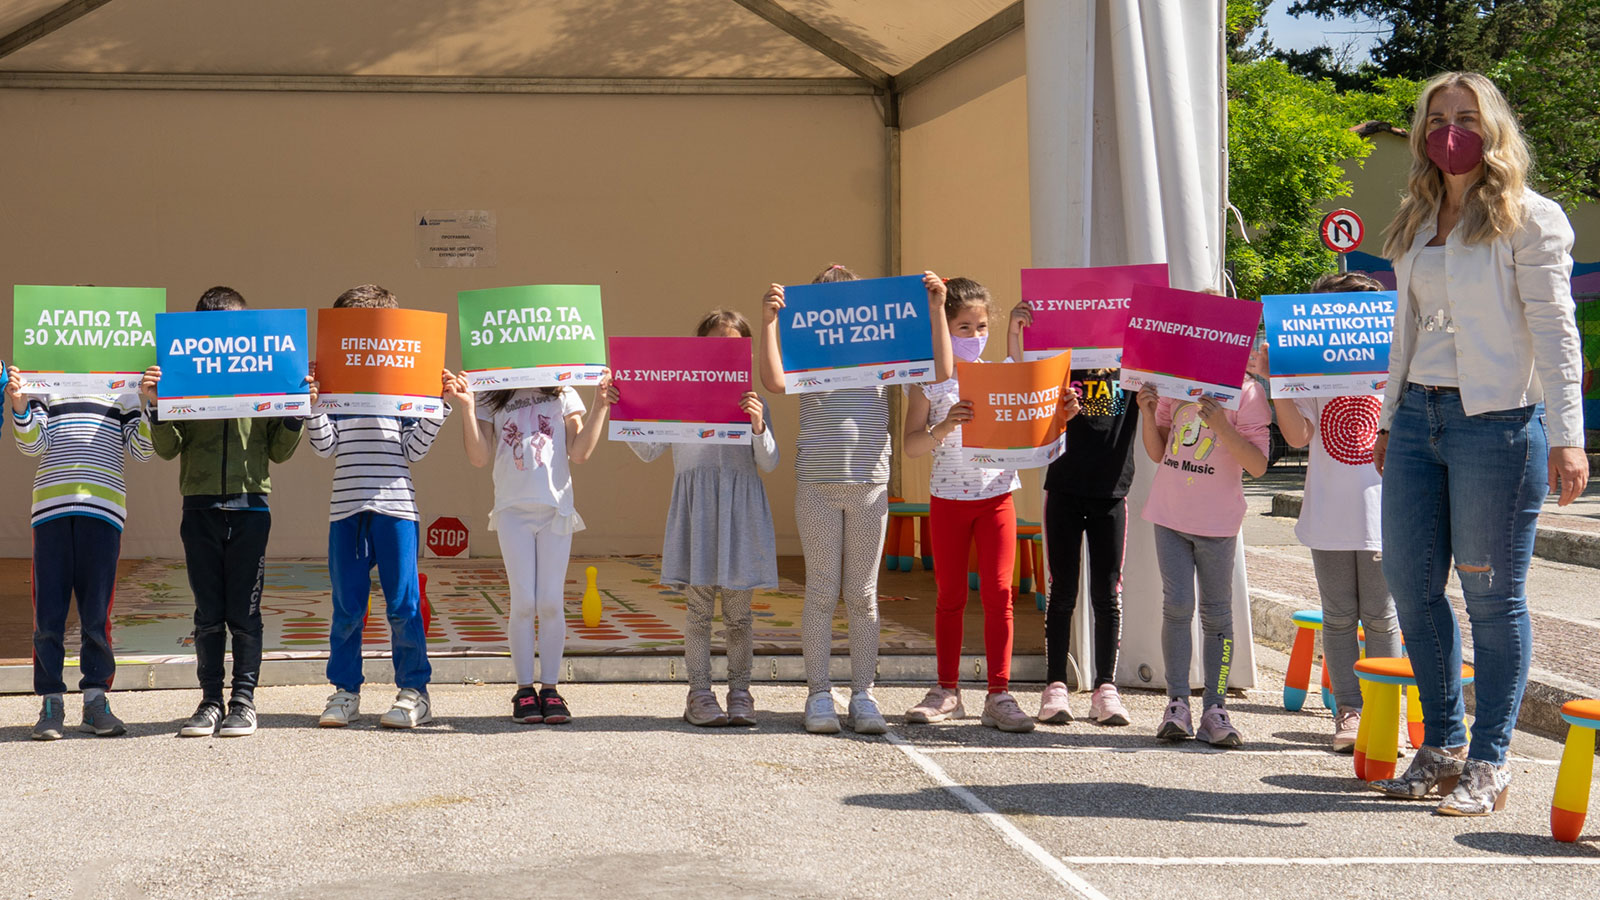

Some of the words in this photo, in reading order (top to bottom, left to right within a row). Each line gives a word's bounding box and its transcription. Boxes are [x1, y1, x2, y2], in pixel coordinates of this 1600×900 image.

[1047, 298, 1132, 312] ΣΥΝΕΡΓΑΣΤΟ
[1292, 305, 1306, 316] Η
[1311, 301, 1395, 316] ΑΣΦΑΛΗΣ
[38, 310, 111, 327] ΑΓΑΠΩ
[116, 311, 142, 327] ΤΑ
[483, 307, 552, 327] ΑΓΑΠΩ
[556, 307, 582, 323] ΤΑ
[792, 305, 878, 329] ΔΡΟΜΟΙ
[885, 302, 918, 321] ΓΙΑ
[1281, 316, 1396, 332] ΚΙΝΗΤΙΚΟΤΗΤ
[24, 329, 49, 346] 30
[55, 329, 155, 348] ΧΛΜ/ΩΡΑ
[471, 330, 494, 347] 30
[498, 324, 596, 344] ΧΛΜ/ΩΡΑ
[815, 328, 844, 346] ΤΗ
[849, 323, 894, 343] ΖΩΗ
[1128, 317, 1144, 329] ΑΣ
[1144, 319, 1252, 348] ΣΥΝΕΡΓΑΣΤΟΥΜΕ!
[1277, 333, 1324, 347] ΕΙΝΑΙ
[169, 336, 258, 356] ΔΡΟΜΟΙ
[264, 335, 297, 353] ΓΙΑ
[341, 338, 422, 354] ΕΠΕΝΔΥΣΤΕ
[192, 356, 222, 374] ΤΗ
[228, 355, 273, 373] ΖΩΗ
[345, 353, 362, 366] ΣΕ
[365, 354, 415, 369] ΔΡΑΣΗ
[1322, 348, 1375, 363] ΟΛΩΝ
[614, 370, 632, 381] ΑΣ
[634, 370, 749, 383] ΣΥΝΕΡΓΑΣΤΟΥΜΕ!
[989, 386, 1060, 406] ΕΠΕΝΔΥΣΤΕ
[1070, 380, 1124, 399] STAR
[994, 409, 1013, 422] ΣΕ
[1016, 402, 1057, 421] ΔΡΑΣΗ
[1164, 454, 1179, 469] Love
[1181, 460, 1215, 475] Music
[429, 528, 466, 547] STOP
[1222, 638, 1233, 663] Love
[1217, 665, 1230, 695] Music
